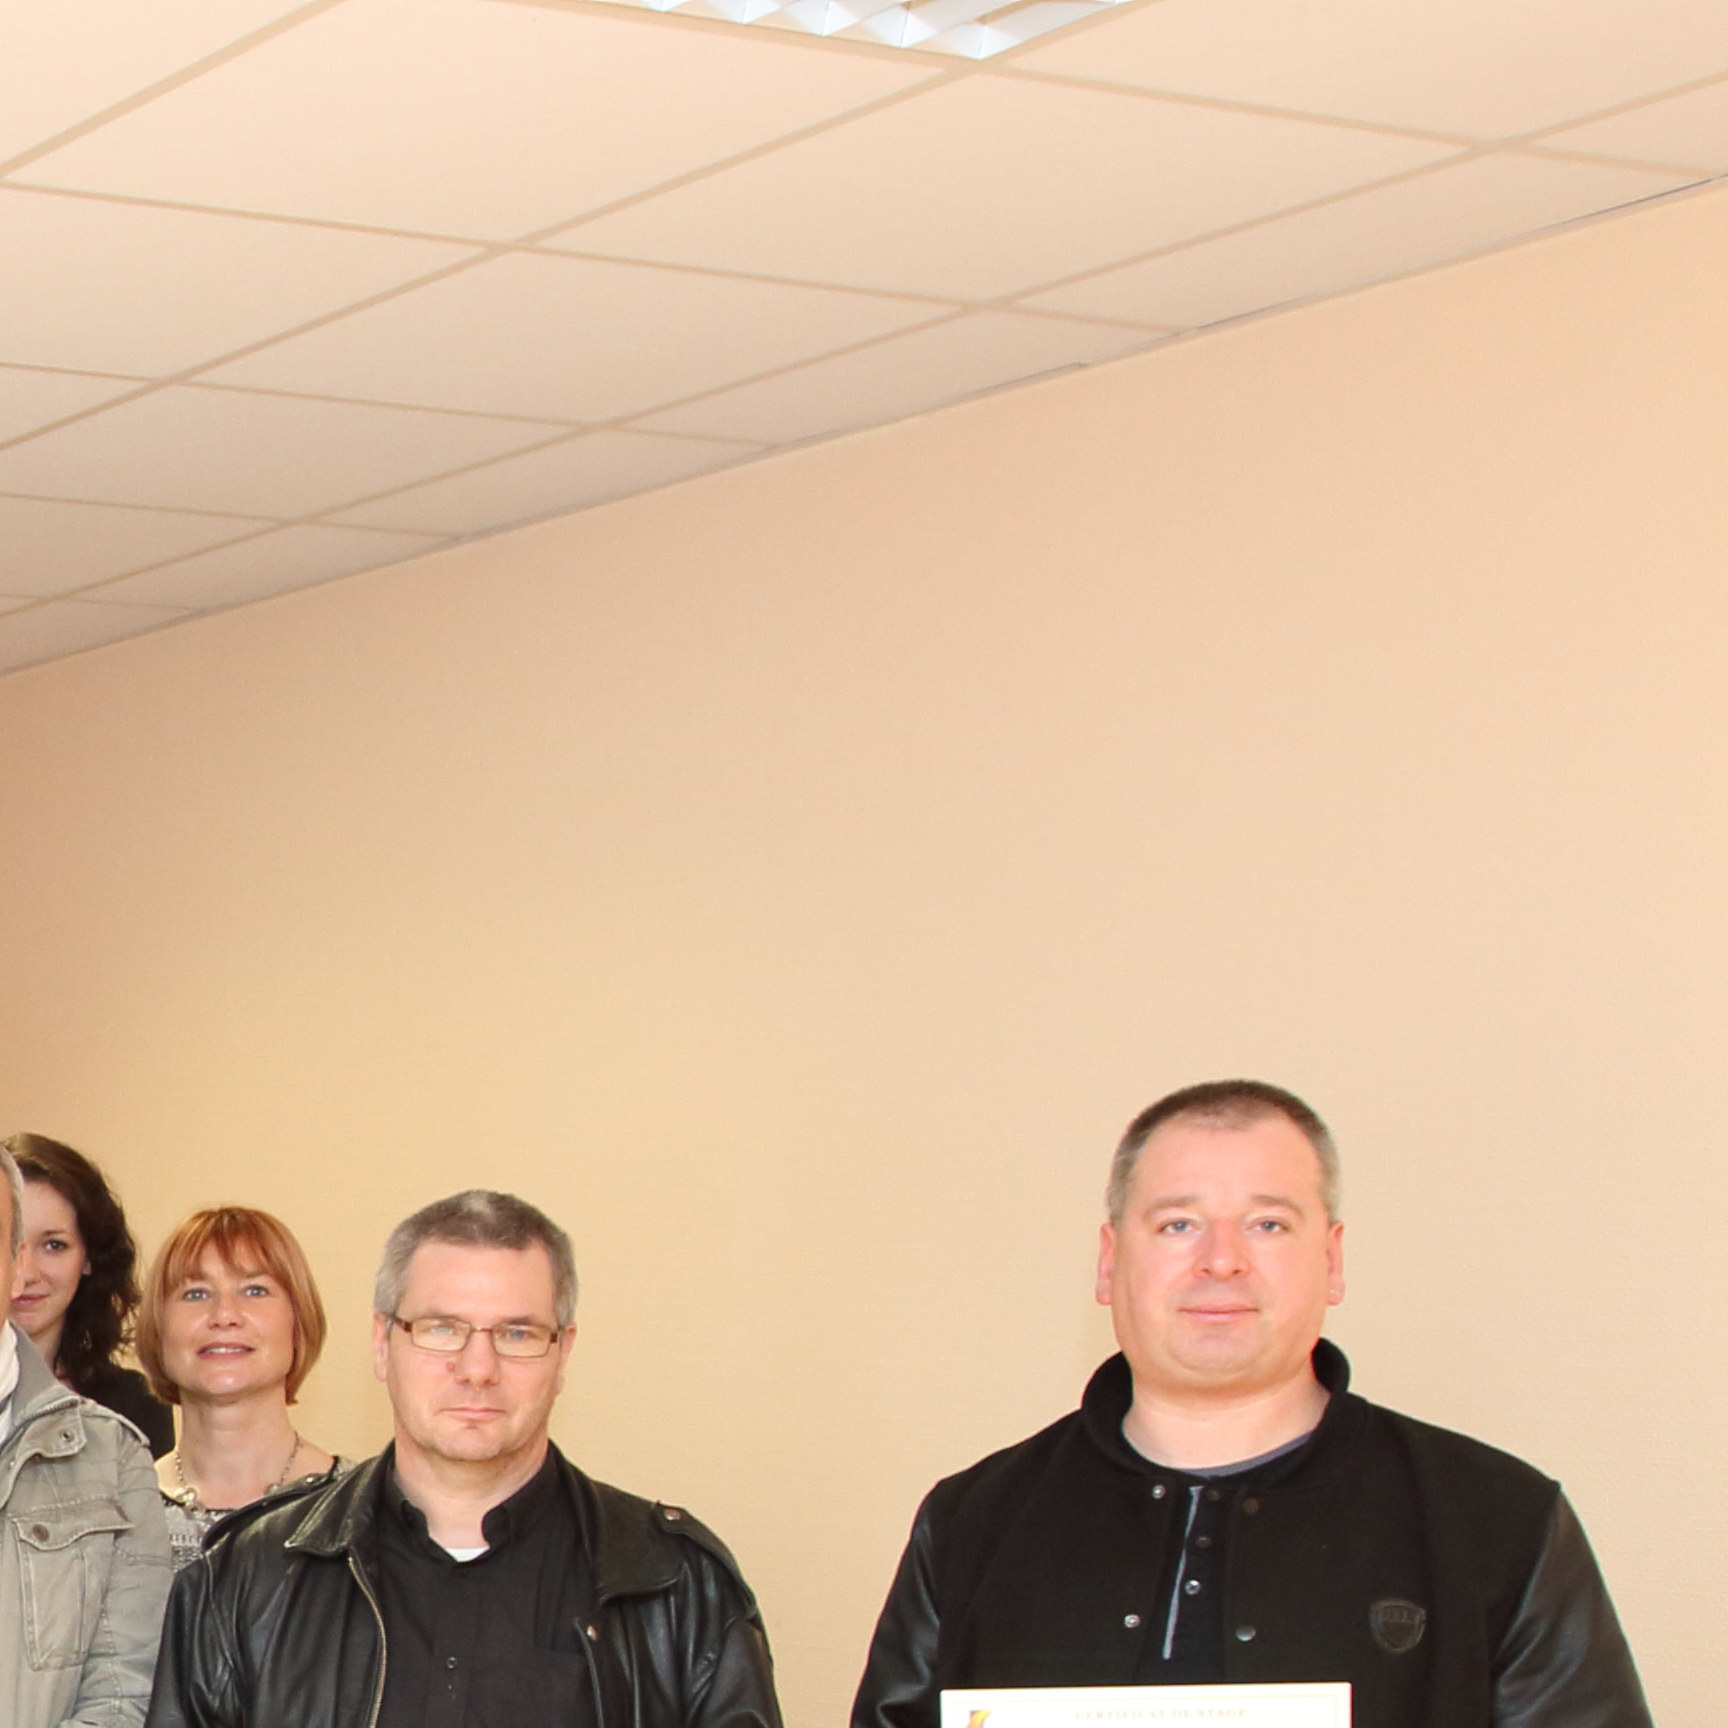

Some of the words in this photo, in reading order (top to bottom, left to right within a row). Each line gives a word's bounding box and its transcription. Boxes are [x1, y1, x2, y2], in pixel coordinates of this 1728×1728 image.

[1074, 1709, 1167, 1720] CERTIFICAT
[1172, 1709, 1192, 1719] DE
[1196, 1708, 1247, 1719] STAGE
